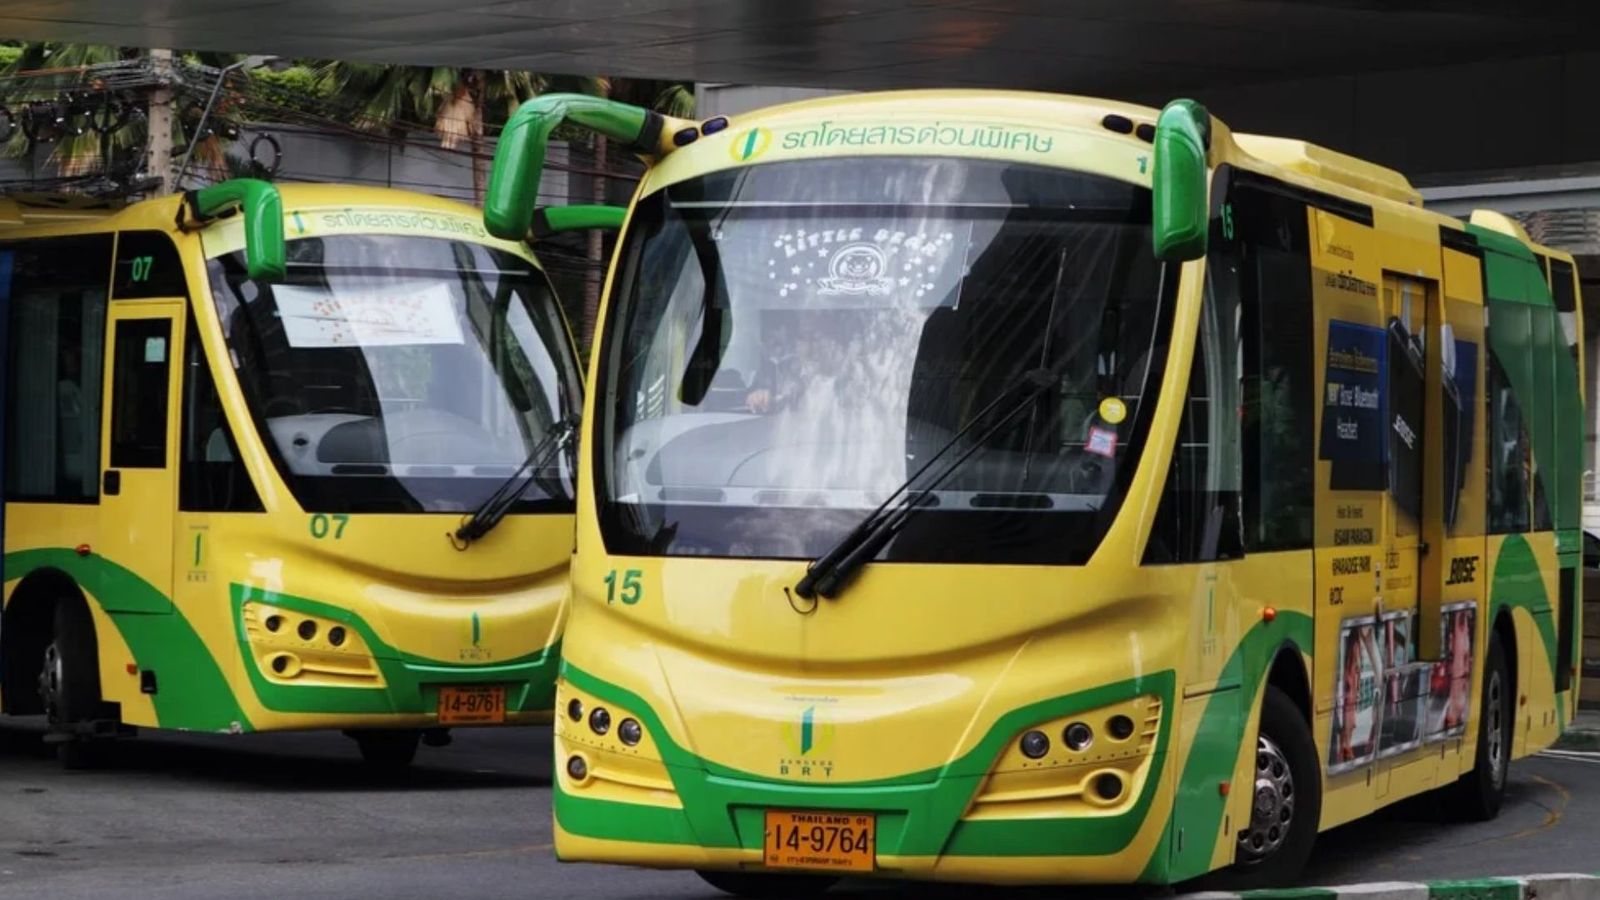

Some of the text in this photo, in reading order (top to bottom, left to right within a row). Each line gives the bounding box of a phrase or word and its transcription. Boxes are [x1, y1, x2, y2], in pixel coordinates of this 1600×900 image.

[782, 121, 1054, 153] รถโดยสารด่วนพิเศษ
[1220, 203, 1234, 240] 15
[131, 256, 153, 282] 07
[310, 513, 349, 540] 07
[1445, 556, 1480, 586] BOSE
[603, 569, 643, 605] 15
[444, 694, 501, 713] 14-9761
[790, 814, 850, 826] THAILAND
[775, 823, 869, 855] 14-9764
